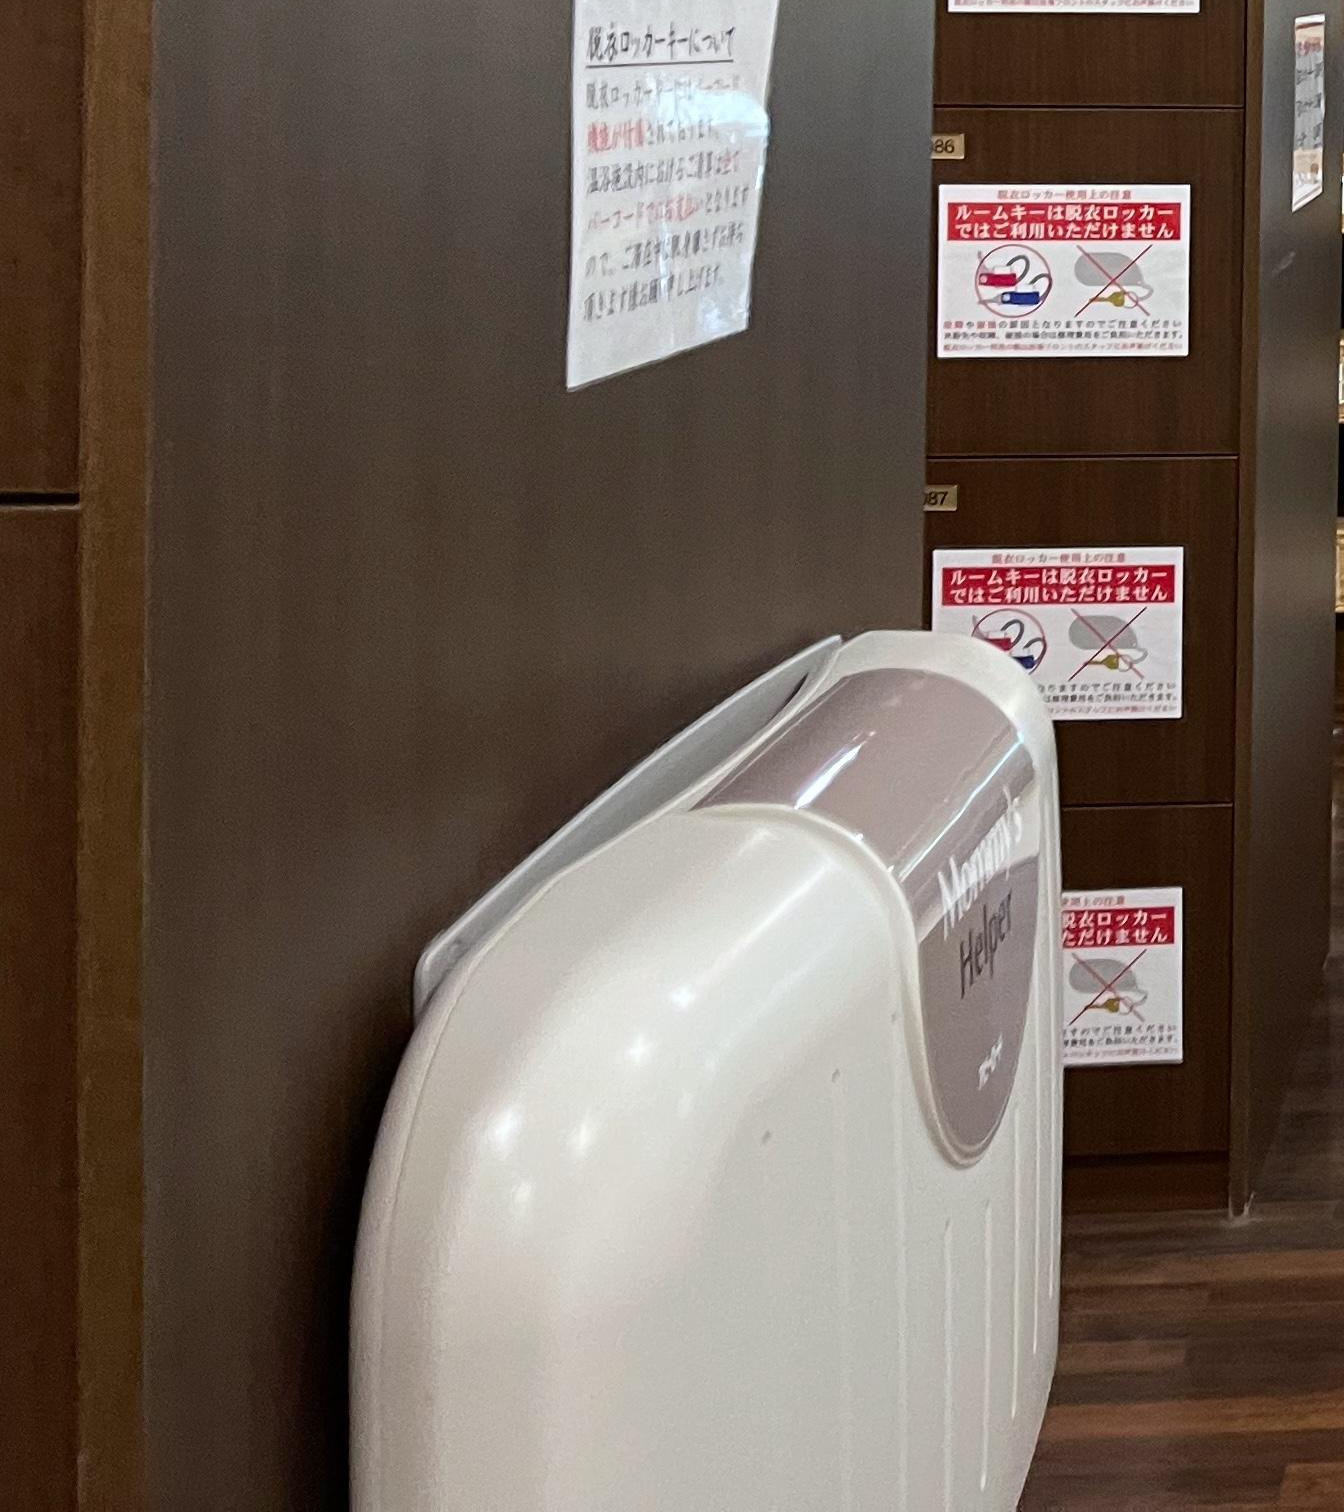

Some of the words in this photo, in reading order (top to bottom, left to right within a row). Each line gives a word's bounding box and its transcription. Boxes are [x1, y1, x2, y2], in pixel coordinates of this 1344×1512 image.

[955, 204, 1174, 221] ルームキーは脱衣ロッカー
[955, 221, 1175, 240] ではご利用いただけません
[923, 490, 949, 506] 87
[950, 568, 1168, 586] ルームキーは脱衣ロッカー
[950, 585, 1168, 604] ではご利用いただけません
[959, 887, 1012, 1001] Helper
[1063, 927, 1168, 946] ただけません
